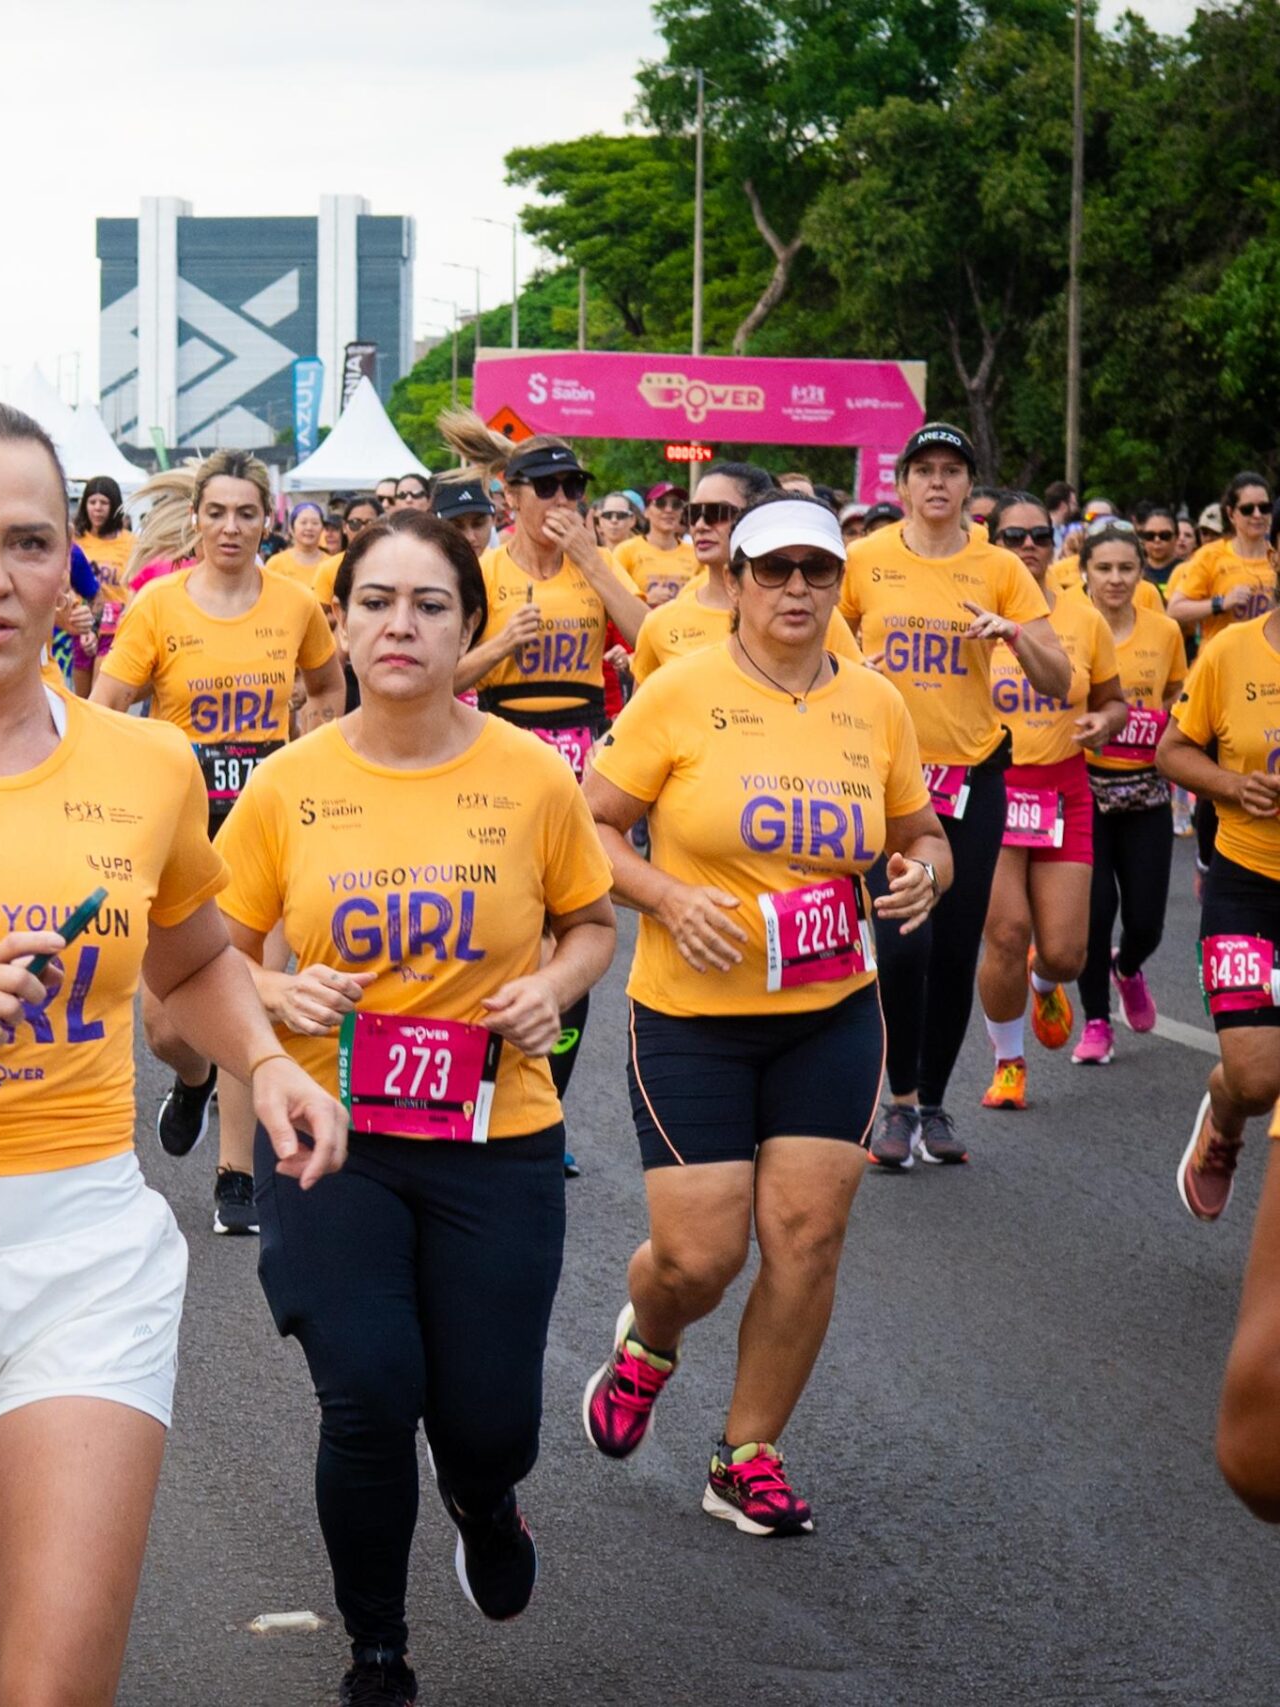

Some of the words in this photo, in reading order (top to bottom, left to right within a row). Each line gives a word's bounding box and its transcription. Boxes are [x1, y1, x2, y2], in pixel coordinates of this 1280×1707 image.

[552, 387, 595, 401] Sabin
[668, 386, 761, 417] POWER
[918, 430, 962, 447] AREZZO
[537, 616, 599, 631] GOYOURUN
[514, 632, 589, 675] GIRL
[885, 631, 968, 676] GIRL
[187, 671, 286, 692] YOUGOYOURUN
[190, 689, 279, 734] GIRL
[731, 714, 764, 725] Sabin
[214, 757, 264, 791] 587
[740, 774, 872, 800] YOUGOYOURUN
[321, 804, 363, 819] Sabin
[1007, 803, 1041, 828] 969
[467, 827, 507, 838] LUPO
[740, 795, 875, 861] GIRL
[86, 854, 132, 873] LUPO
[328, 864, 497, 892] YOUGOYOURUN
[331, 890, 486, 964] GIRL
[795, 901, 850, 955] 2224
[1210, 952, 1260, 989] 3435
[399, 1026, 449, 1044] POWER
[339, 1046, 349, 1099] VERDE
[384, 1044, 452, 1100] 273
